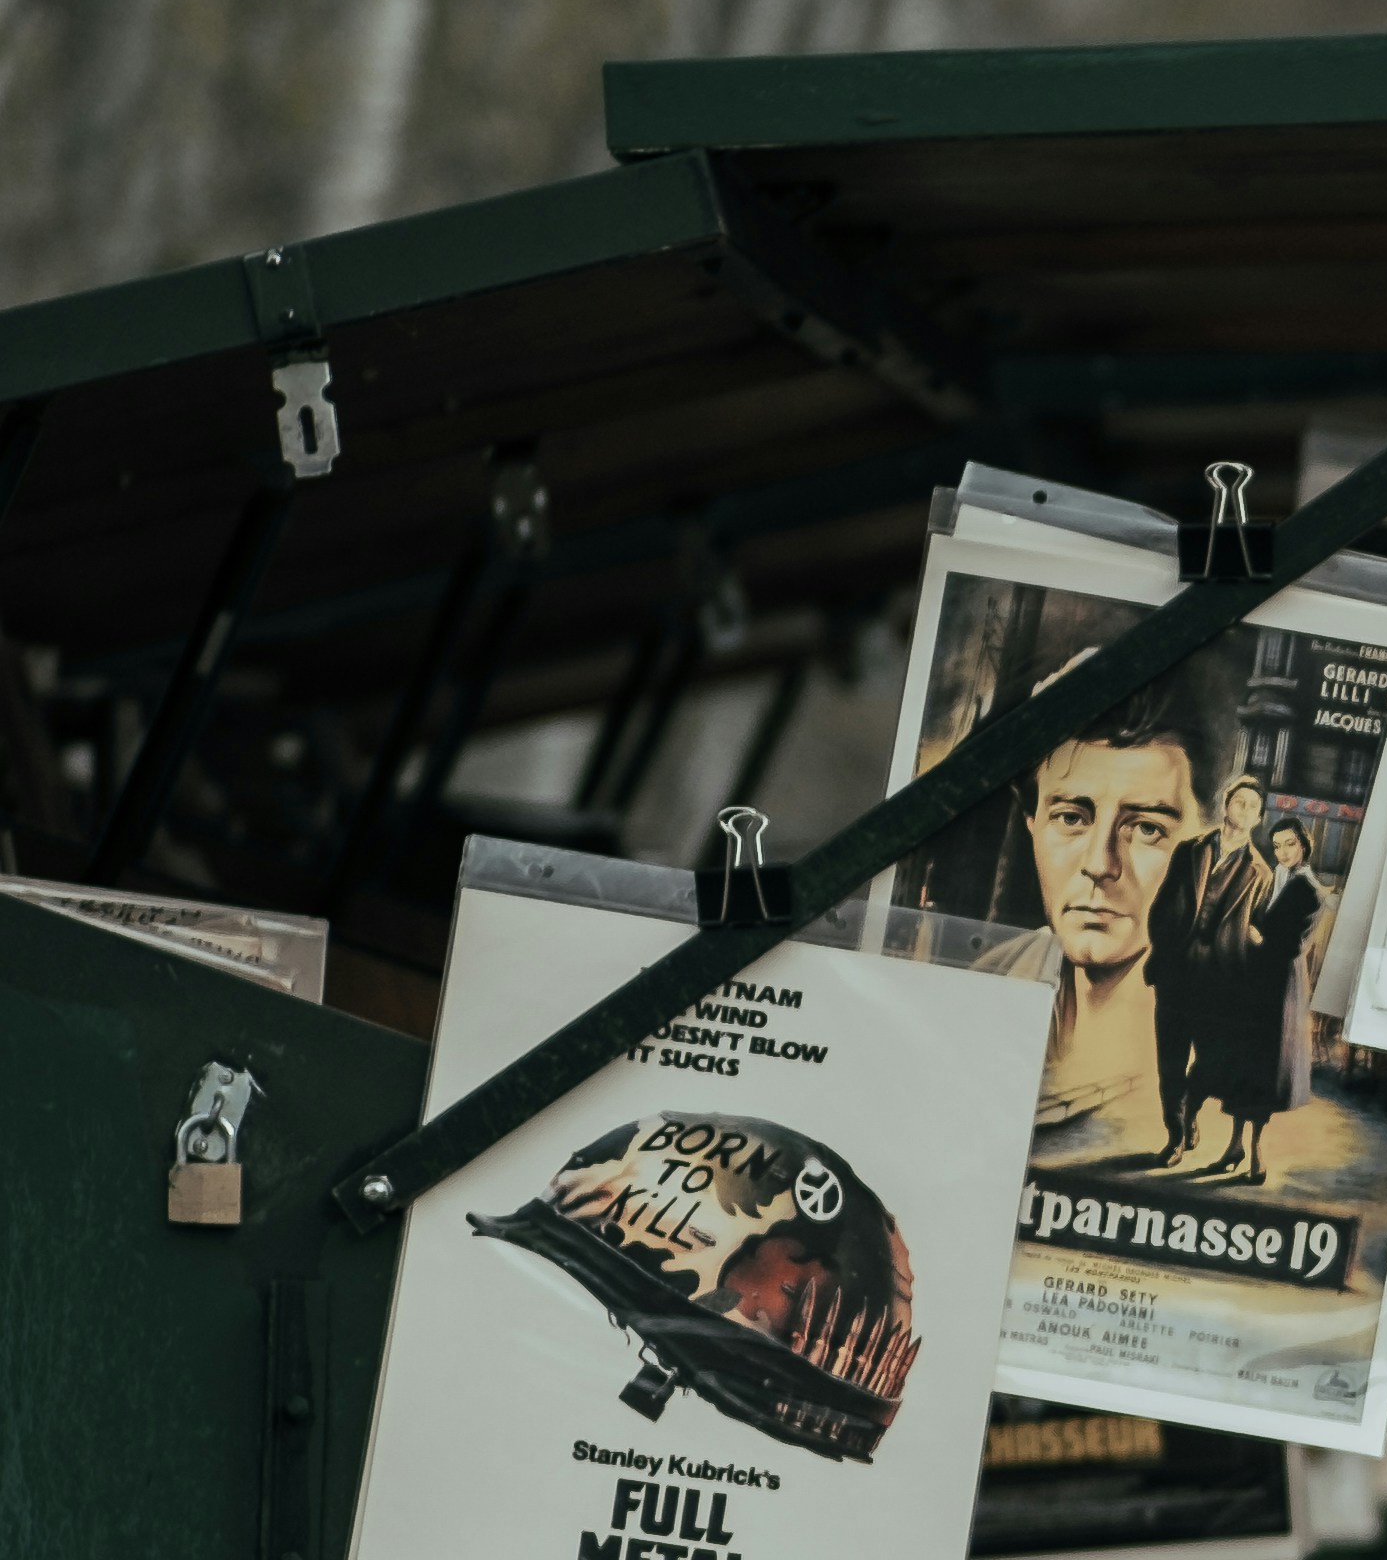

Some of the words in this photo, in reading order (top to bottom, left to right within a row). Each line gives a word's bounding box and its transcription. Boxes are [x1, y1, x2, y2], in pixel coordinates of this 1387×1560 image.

[1321, 680, 1370, 704] LILLI
[1314, 709, 1381, 735] JACQUES
[713, 980, 803, 1009] TNAM
[695, 1001, 768, 1028] WIND
[652, 1022, 745, 1051] OESN'T
[749, 1035, 828, 1063] BLOW
[627, 1045, 655, 1063] IT
[659, 1048, 740, 1076] SUCKS
[638, 1120, 783, 1179] BORN
[662, 1158, 714, 1193] TO
[1018, 1182, 1283, 1263] tparnasse
[1290, 1221, 1338, 1280] 19
[1042, 1292, 1069, 1307] LEA
[1078, 1297, 1155, 1321] PADOVANI
[1044, 1276, 1108, 1298] GERARD
[1120, 1288, 1159, 1306] SETY
[1037, 1319, 1091, 1339] ANOUK
[984, 1416, 1163, 1465] HASSEUR
[572, 1440, 663, 1477] Stanley
[668, 1454, 780, 1490] Kubrick's
[611, 1478, 734, 1545] FULL
